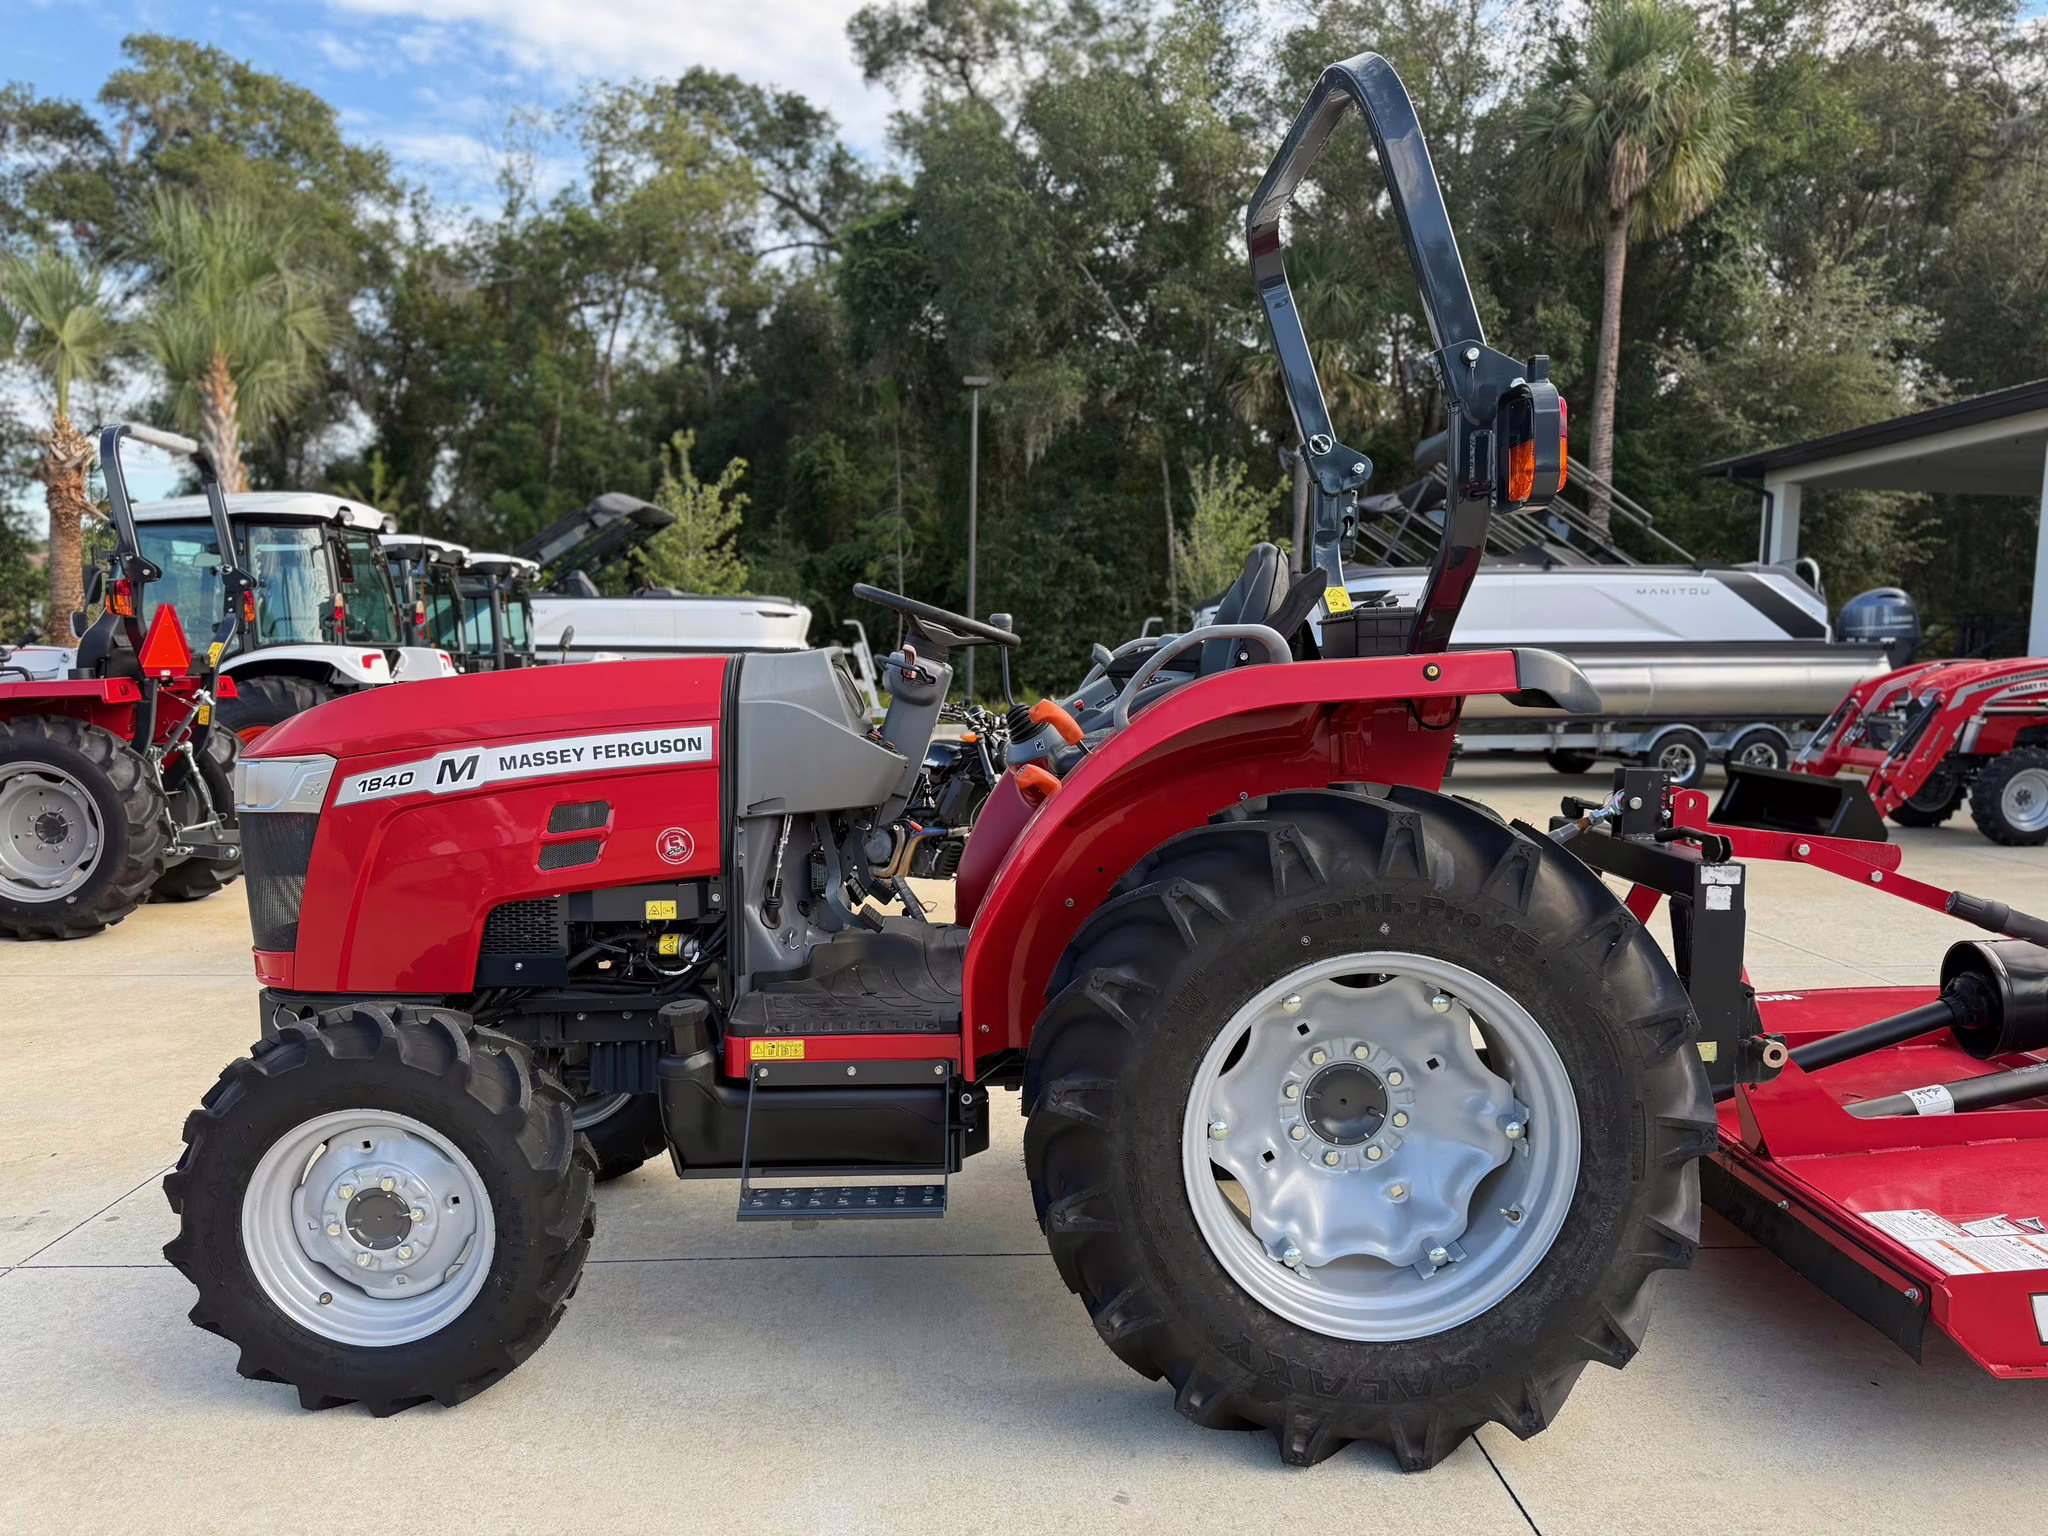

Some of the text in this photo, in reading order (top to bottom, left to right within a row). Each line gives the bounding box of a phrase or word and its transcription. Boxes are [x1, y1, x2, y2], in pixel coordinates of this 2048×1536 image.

[1636, 587, 1710, 596] MANITOU
[1978, 676, 2009, 689] MASSEY
[2008, 683, 2038, 693] MASSEY
[358, 736, 703, 793] 1840 M MASSEY FERGUSON
[1295, 892, 1543, 959] Earth-Pro 45
[1218, 1332, 1483, 1405] GALAXY
